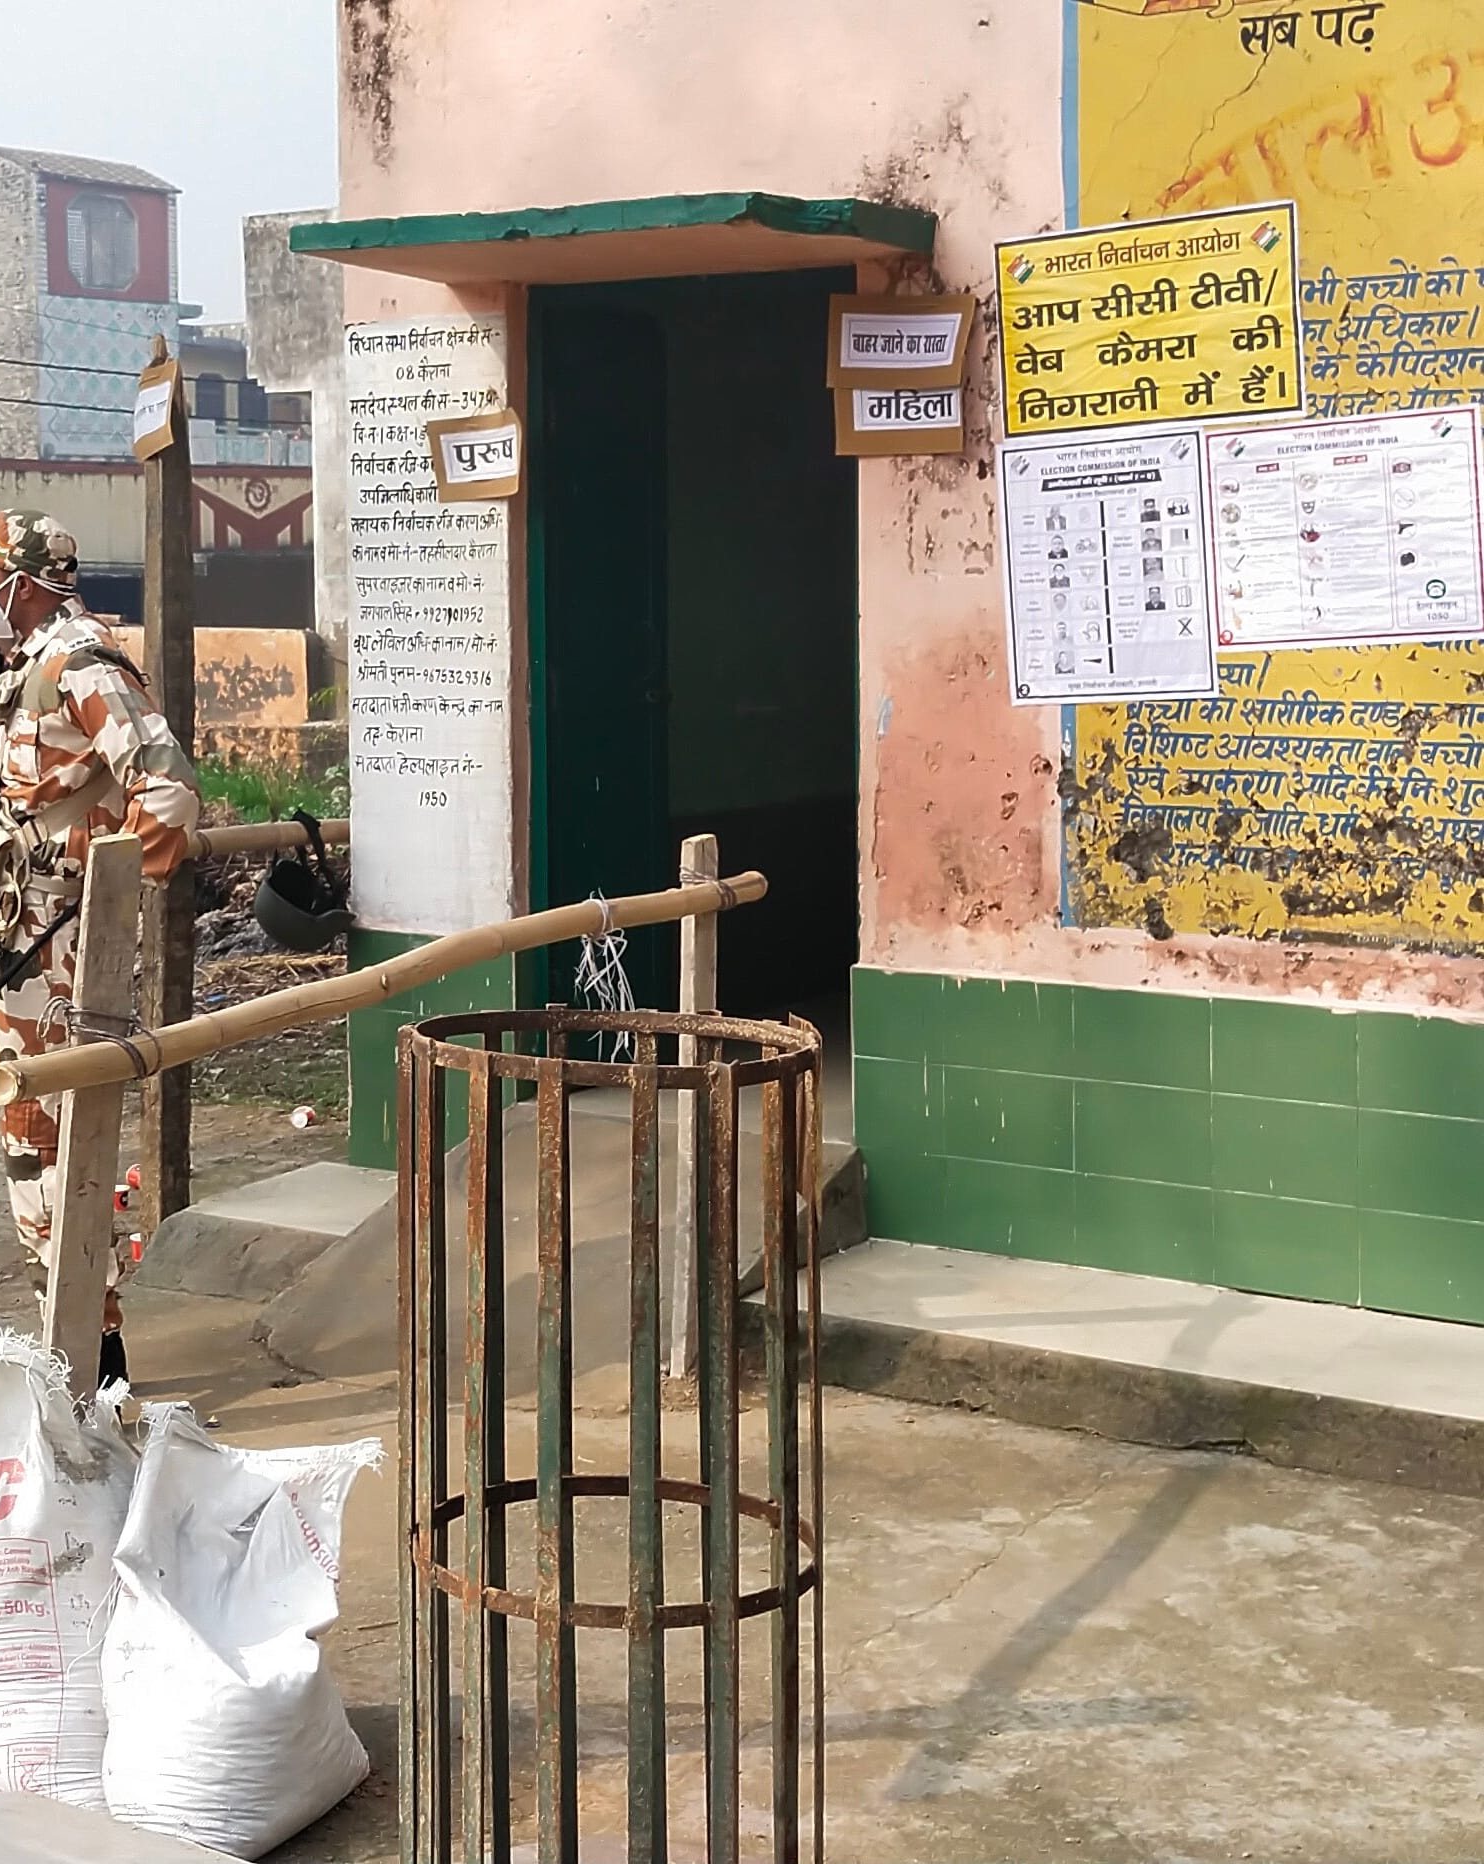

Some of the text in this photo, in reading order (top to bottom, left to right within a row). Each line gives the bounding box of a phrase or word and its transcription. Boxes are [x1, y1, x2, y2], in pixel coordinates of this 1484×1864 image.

[1239, 12, 1302, 54] सब
[1045, 228, 1241, 275] भारत निर्वाचन आयोग
[1300, 266, 1343, 305] भी
[1347, 258, 1422, 303] बच्चों
[1425, 256, 1469, 297] को
[1012, 267, 1278, 330] आप सीसी टीवी/
[349, 331, 384, 356] विधान
[386, 334, 406, 354] सभा
[408, 328, 445, 350] निर्वाचन
[446, 326, 467, 349] क्षेत्र
[466, 324, 480, 346] की
[852, 329, 948, 354] बाहर जाने का रास्ता
[1015, 314, 1284, 376] वेब कैमरा की
[396, 356, 452, 382] 08 कैराना
[349, 391, 386, 418] मतदेय
[387, 394, 421, 416] स्थल
[421, 389, 437, 411] की
[868, 389, 953, 421] महिला
[1017, 376, 1160, 423] निगरानी
[1183, 370, 1221, 406] में
[1277, 436, 1399, 455] ELECTION COMMISSION OF INDIA
[351, 453, 398, 476] निर्वाचक
[1040, 457, 1161, 476] ELECTION COMMISSION OF INDIA
[351, 517, 391, 536] सहायक
[392, 510, 436, 531] निर्वाचक
[419, 539, 467, 564] तहसीलदार
[468, 538, 498, 559] कैराना
[426, 577, 447, 592] नाम
[447, 577, 456, 593] व
[360, 604, 393, 622] जगपाल
[357, 659, 387, 682] श्रीमती
[352, 696, 392, 715] मतदाता
[468, 700, 484, 717] का
[484, 700, 504, 714] नाम
[1240, 689, 1346, 728] शारीरिक
[1350, 701, 1406, 728] दण्ड
[386, 722, 423, 744] कैराना
[1123, 722, 1214, 760] विशिष्ट
[1215, 733, 1367, 767] आवश्यकता
[355, 755, 395, 775] मतदाता
[397, 751, 459, 778] हेल्पलाइन
[419, 791, 448, 807] 1950
[1248, 801, 1310, 840] जाति
